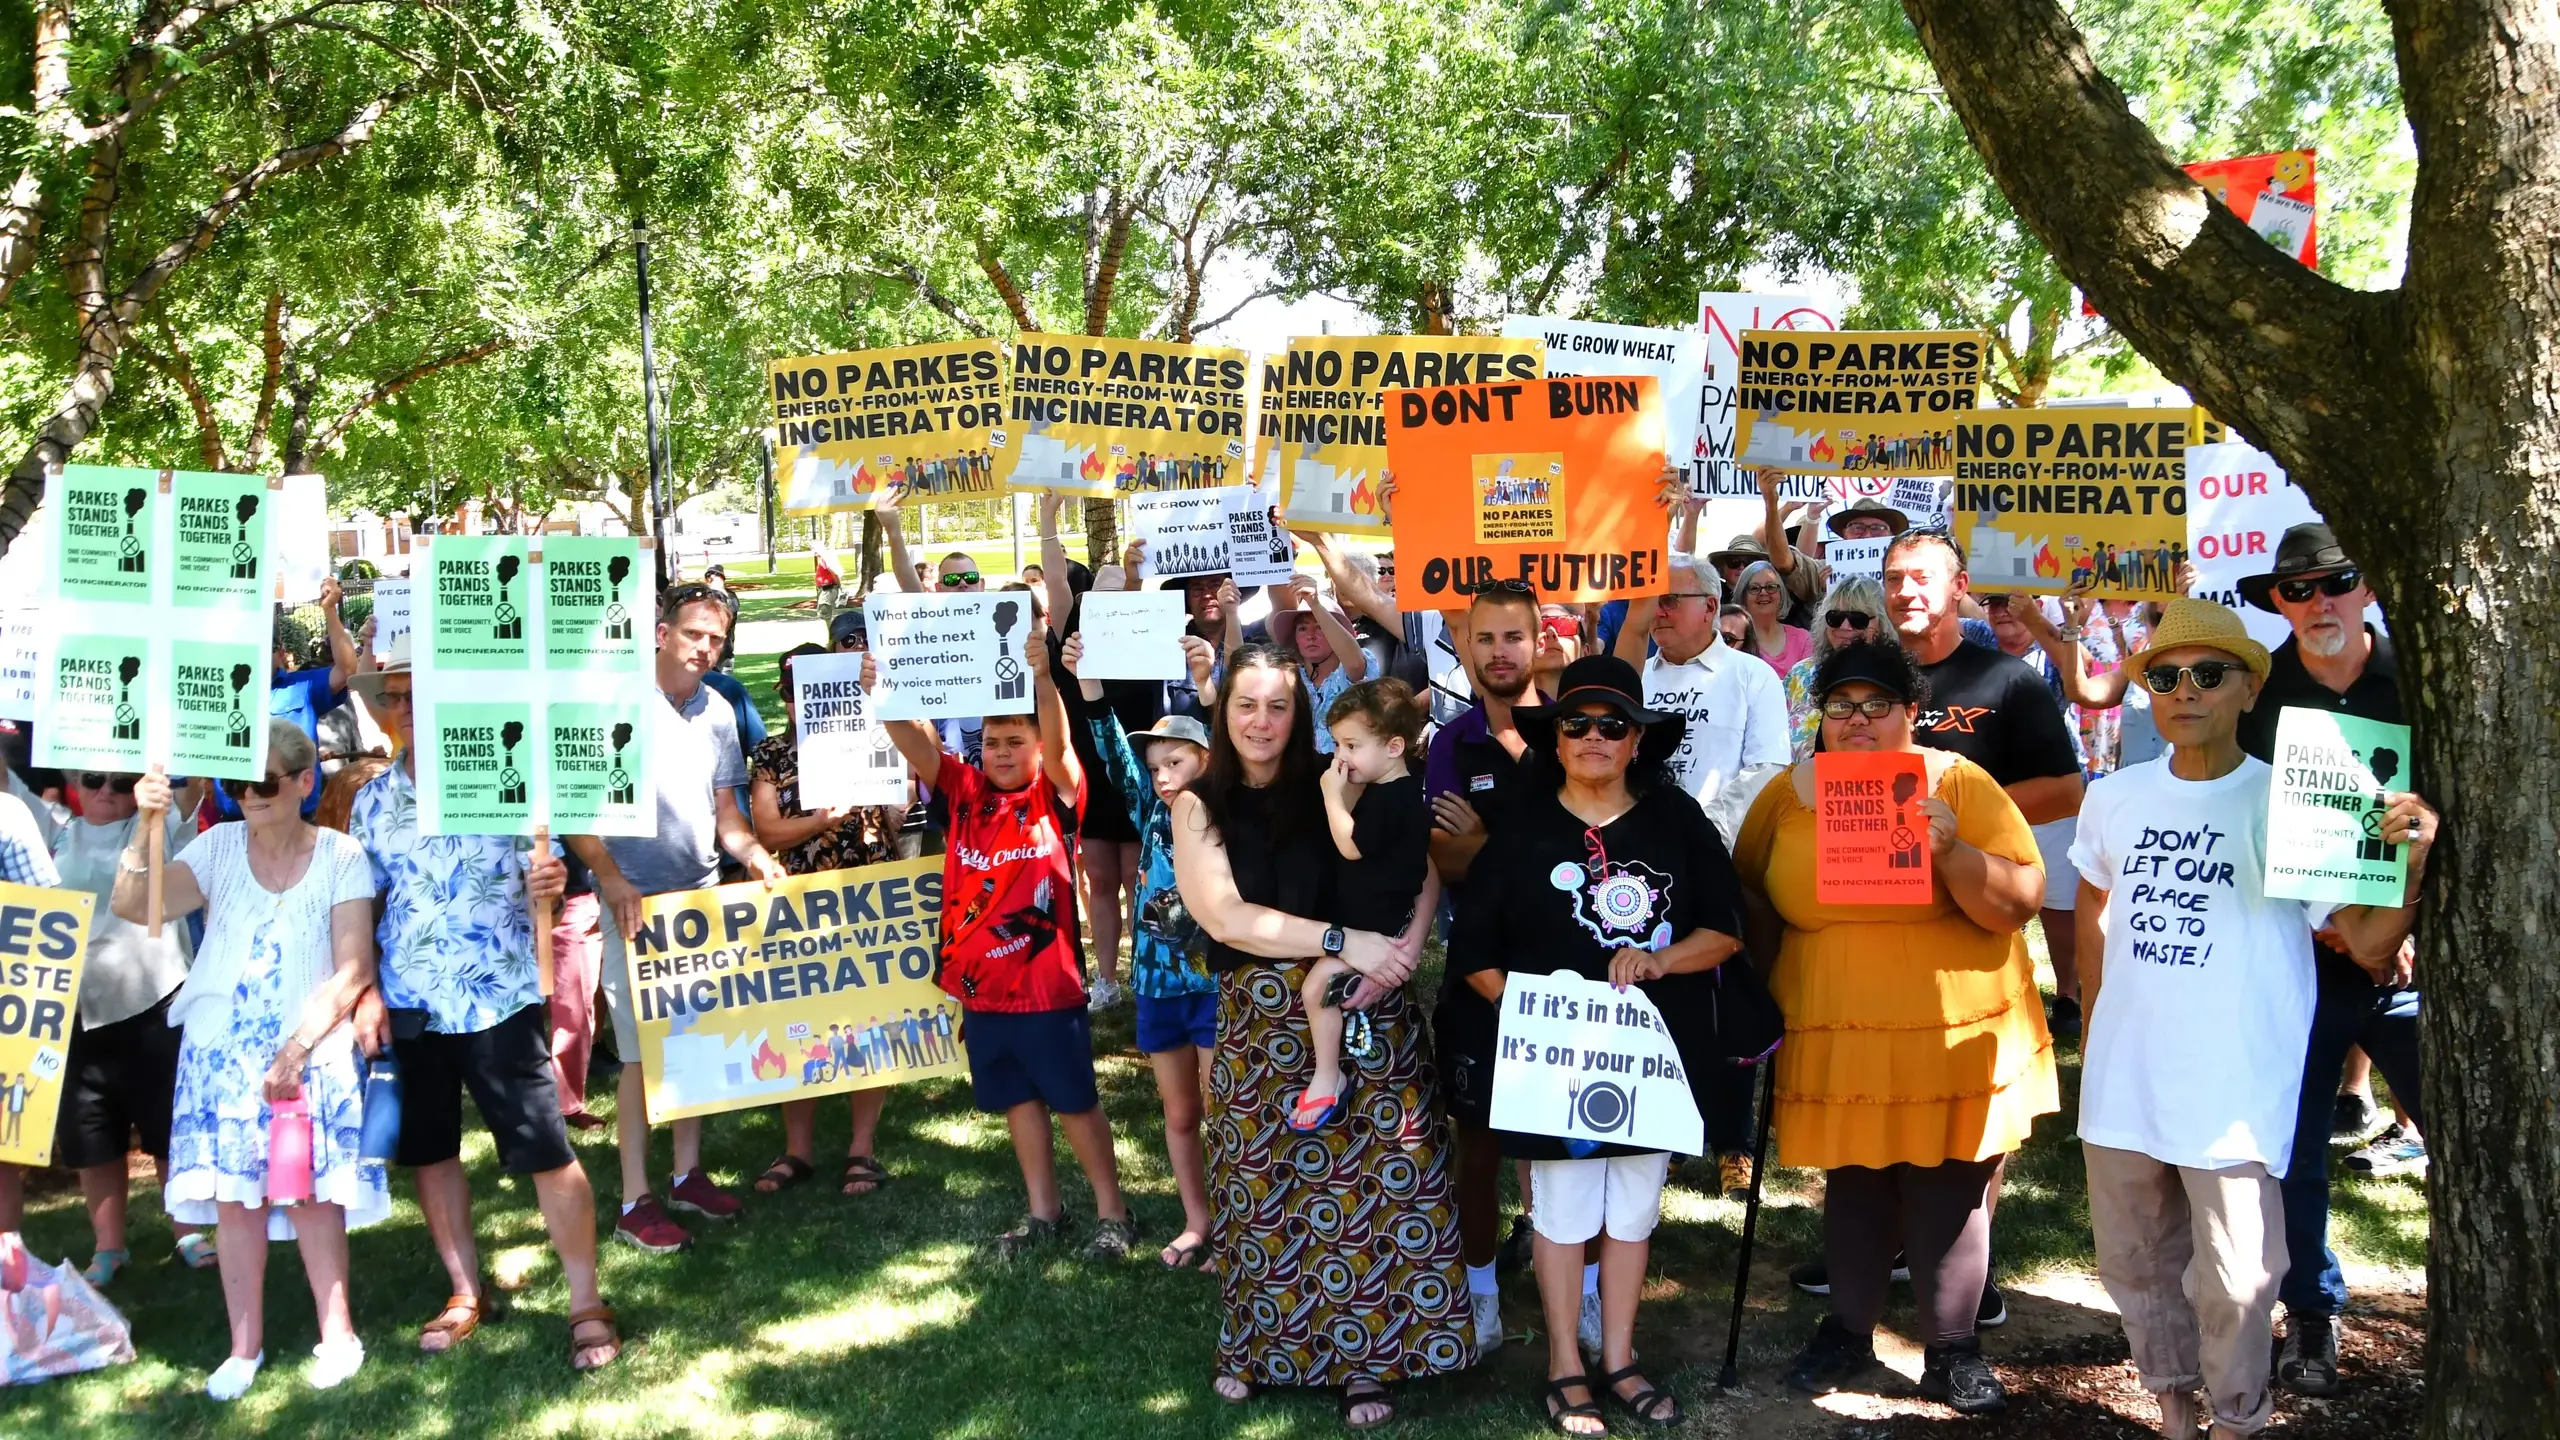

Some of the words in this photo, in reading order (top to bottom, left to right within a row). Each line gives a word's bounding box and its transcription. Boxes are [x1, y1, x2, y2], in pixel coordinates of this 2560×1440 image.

[2292, 202, 2314, 214] NOT
[1545, 332, 1568, 350] WE
[1573, 335, 1619, 356] GROW
[1623, 340, 1676, 364] WHEAT,
[1742, 341, 1799, 370] NO
[1809, 342, 1979, 370] PARKES
[1015, 344, 1070, 376] NO
[1080, 348, 1245, 390] PARKES
[1288, 350, 1342, 386] NO
[1352, 351, 1537, 387] PARKES
[774, 369, 827, 400] NO
[836, 351, 998, 394] PARKES
[1742, 371, 1976, 387] ENERGY-FROM-WASTE
[777, 383, 1000, 418] ENERGY-FROM-WASTE
[1014, 377, 1244, 408] ENERGY-FROM-WASTE
[1402, 386, 1522, 428] DONT
[1548, 381, 1640, 419] BURN
[1740, 388, 1974, 414] INCINERATOR
[779, 402, 1002, 446] INCINERATOR
[1012, 396, 1242, 436] INCINERATOR
[991, 433, 1006, 442] NO
[1956, 424, 2014, 458] NO
[1228, 442, 1242, 454] NO
[1897, 479, 1934, 492] PARKES
[2200, 472, 2268, 500] OUR
[68, 490, 117, 506] PARKES
[1160, 500, 1200, 508] GROW
[1894, 490, 1932, 504] STANDS
[1957, 484, 2186, 515] INCINERATO
[181, 498, 230, 513] PARKES
[1892, 499, 1932, 513] TOGETHER
[68, 507, 117, 523] STANDS
[180, 514, 228, 530] STANDS
[1229, 511, 1263, 522] PARKES
[1483, 511, 1500, 520] NO
[1502, 510, 1552, 520] PARKES
[68, 524, 119, 537] TOGETHER
[1158, 526, 1186, 534] NOT
[1231, 522, 1264, 534] STANDS
[1484, 529, 1553, 538] INCINERATOR
[180, 531, 231, 544] TOGETHER
[1232, 534, 1268, 544] TOGETHER
[2198, 531, 2267, 559] OUR
[1835, 549, 1844, 561] If
[1847, 548, 1864, 560] it's
[1868, 547, 1879, 558] in
[439, 560, 490, 575] PARKES
[550, 562, 601, 576] PARKES
[1422, 556, 1493, 596] OUR
[1520, 550, 1658, 591] FUTURE!
[80, 578, 147, 588] INCINERATOR
[193, 586, 256, 594] INCINERATOR
[439, 578, 490, 592] STANDS
[550, 578, 602, 592] STANDS
[439, 594, 493, 606] TOGETHER
[551, 595, 604, 606] TOGETHER
[873, 610, 908, 622] What
[912, 607, 950, 619] about
[954, 603, 980, 616] me?
[880, 634, 884, 646] I
[888, 636, 910, 646] am
[914, 631, 938, 644] the
[942, 630, 976, 642] next
[60, 658, 112, 674] PARKES
[889, 651, 974, 670] generation.
[178, 665, 224, 682] PARKES
[60, 675, 111, 690] STANDS
[178, 682, 224, 698] STANDS
[802, 680, 862, 700] PARKES
[882, 678, 899, 692] My
[902, 677, 932, 688] voice
[935, 675, 982, 686] matters
[60, 692, 114, 704] TOGETHER
[921, 692, 947, 706] too!
[1648, 687, 1704, 706] DON'T
[178, 699, 226, 712] TOGETHER
[804, 700, 862, 719] STANDS
[554, 728, 604, 741] PARKES
[804, 718, 866, 735] TOGETHER
[443, 728, 494, 742] PARKES
[188, 754, 252, 763] INCINERATOR
[444, 744, 494, 758] STANDS
[555, 744, 604, 758] STANDS
[444, 760, 498, 771] TOGETHER
[556, 760, 608, 772] TOGETHER
[2284, 768, 2360, 792] STANDS
[1824, 780, 1884, 797] PARKES
[1825, 800, 1884, 816] STANDS
[2284, 791, 2362, 812] TOGETHER
[1826, 818, 1888, 832] TOGETHER
[2134, 824, 2225, 856] DON'T
[1826, 856, 1840, 864] ONE
[2123, 856, 2169, 878] LET
[2175, 858, 2234, 888] OUR
[2274, 866, 2294, 874] NO
[2298, 868, 2396, 883] INCINERATOR
[2132, 884, 2209, 912] PLACE
[634, 908, 710, 956] NO
[723, 872, 943, 942] PARKES
[2130, 912, 2166, 932] GO
[2176, 916, 2205, 936] TO
[638, 918, 939, 982] ENERGY-FROM-WAST
[640, 943, 938, 1021] INCINERATO
[1519, 992, 1536, 1015] If
[1543, 994, 1578, 1020] it's
[1587, 998, 1608, 1023] in
[1616, 1003, 1650, 1028] the
[788, 1024, 806, 1034] NO
[37, 1052, 60, 1070] NO
[1502, 1036, 1537, 1062] It's
[1545, 1046, 1574, 1066] on
[1582, 1050, 1634, 1074] your
